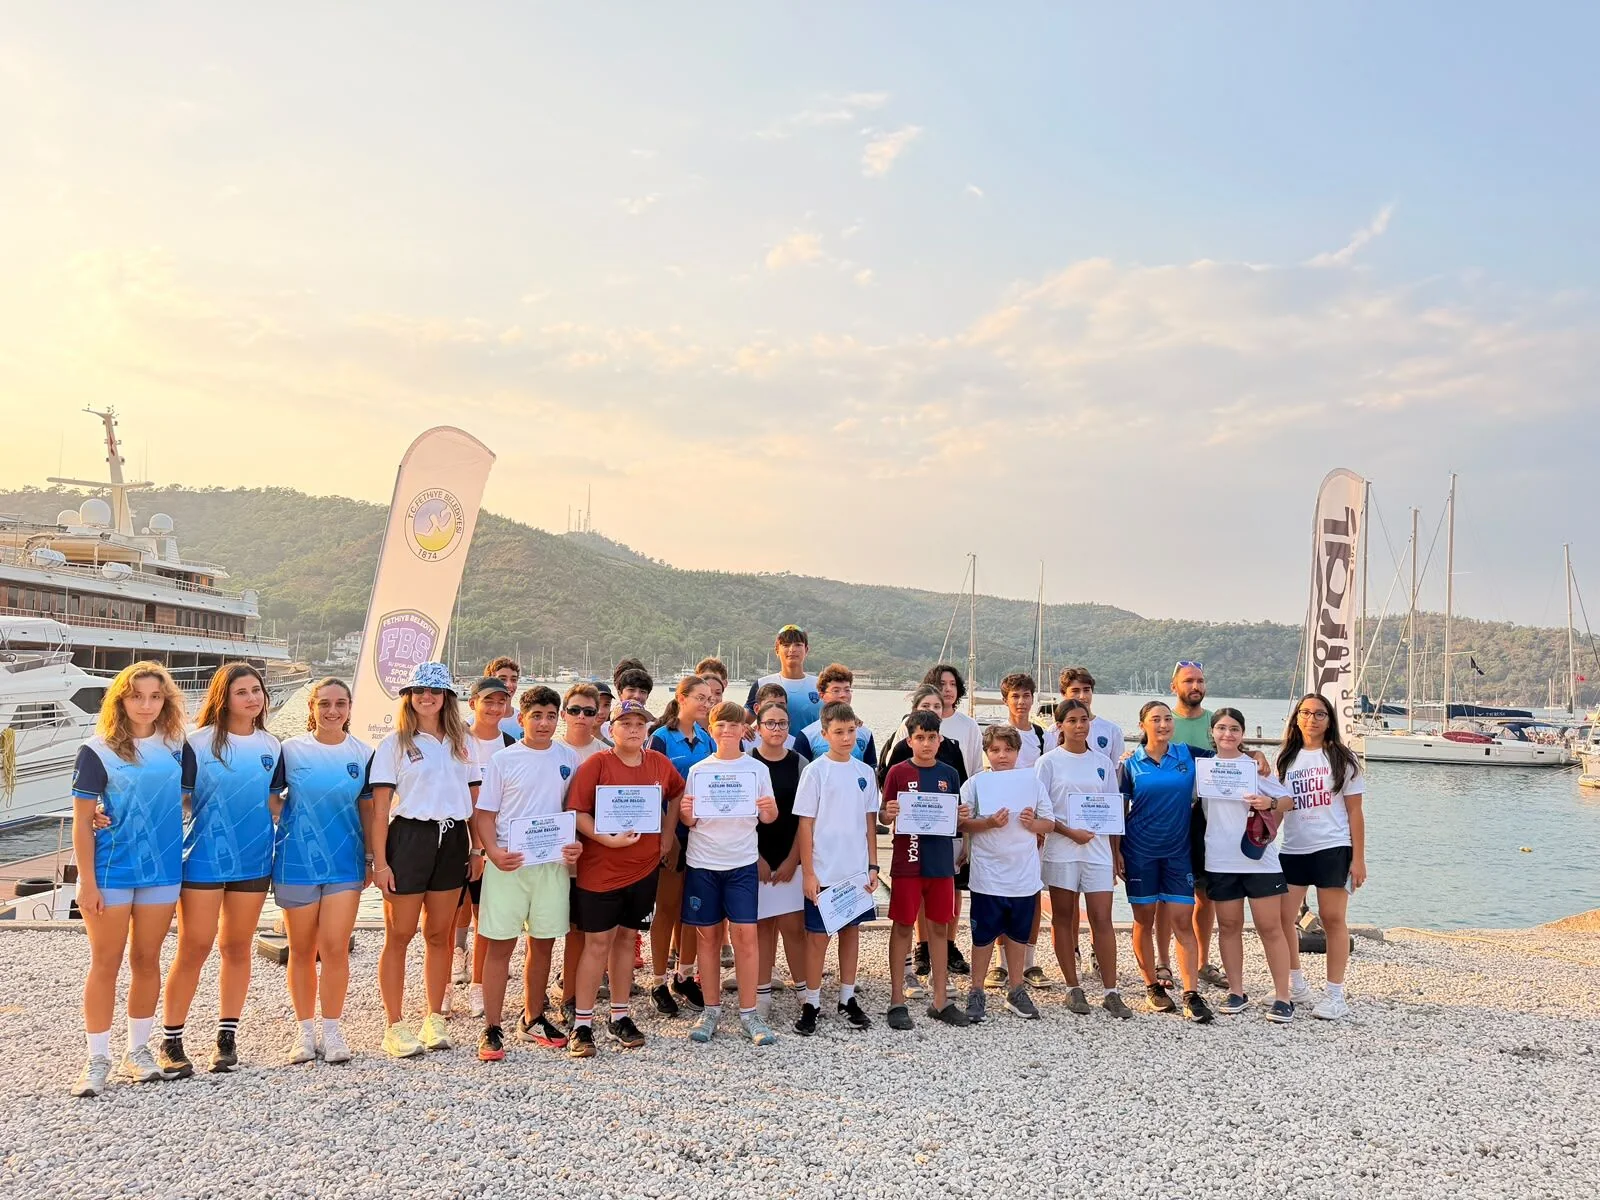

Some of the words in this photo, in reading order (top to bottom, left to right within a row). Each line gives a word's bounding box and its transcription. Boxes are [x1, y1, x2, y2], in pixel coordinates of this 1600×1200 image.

[418, 548, 437, 560] 1874
[379, 627, 431, 664] FBS
[1292, 776, 1324, 795] GÜCÜ
